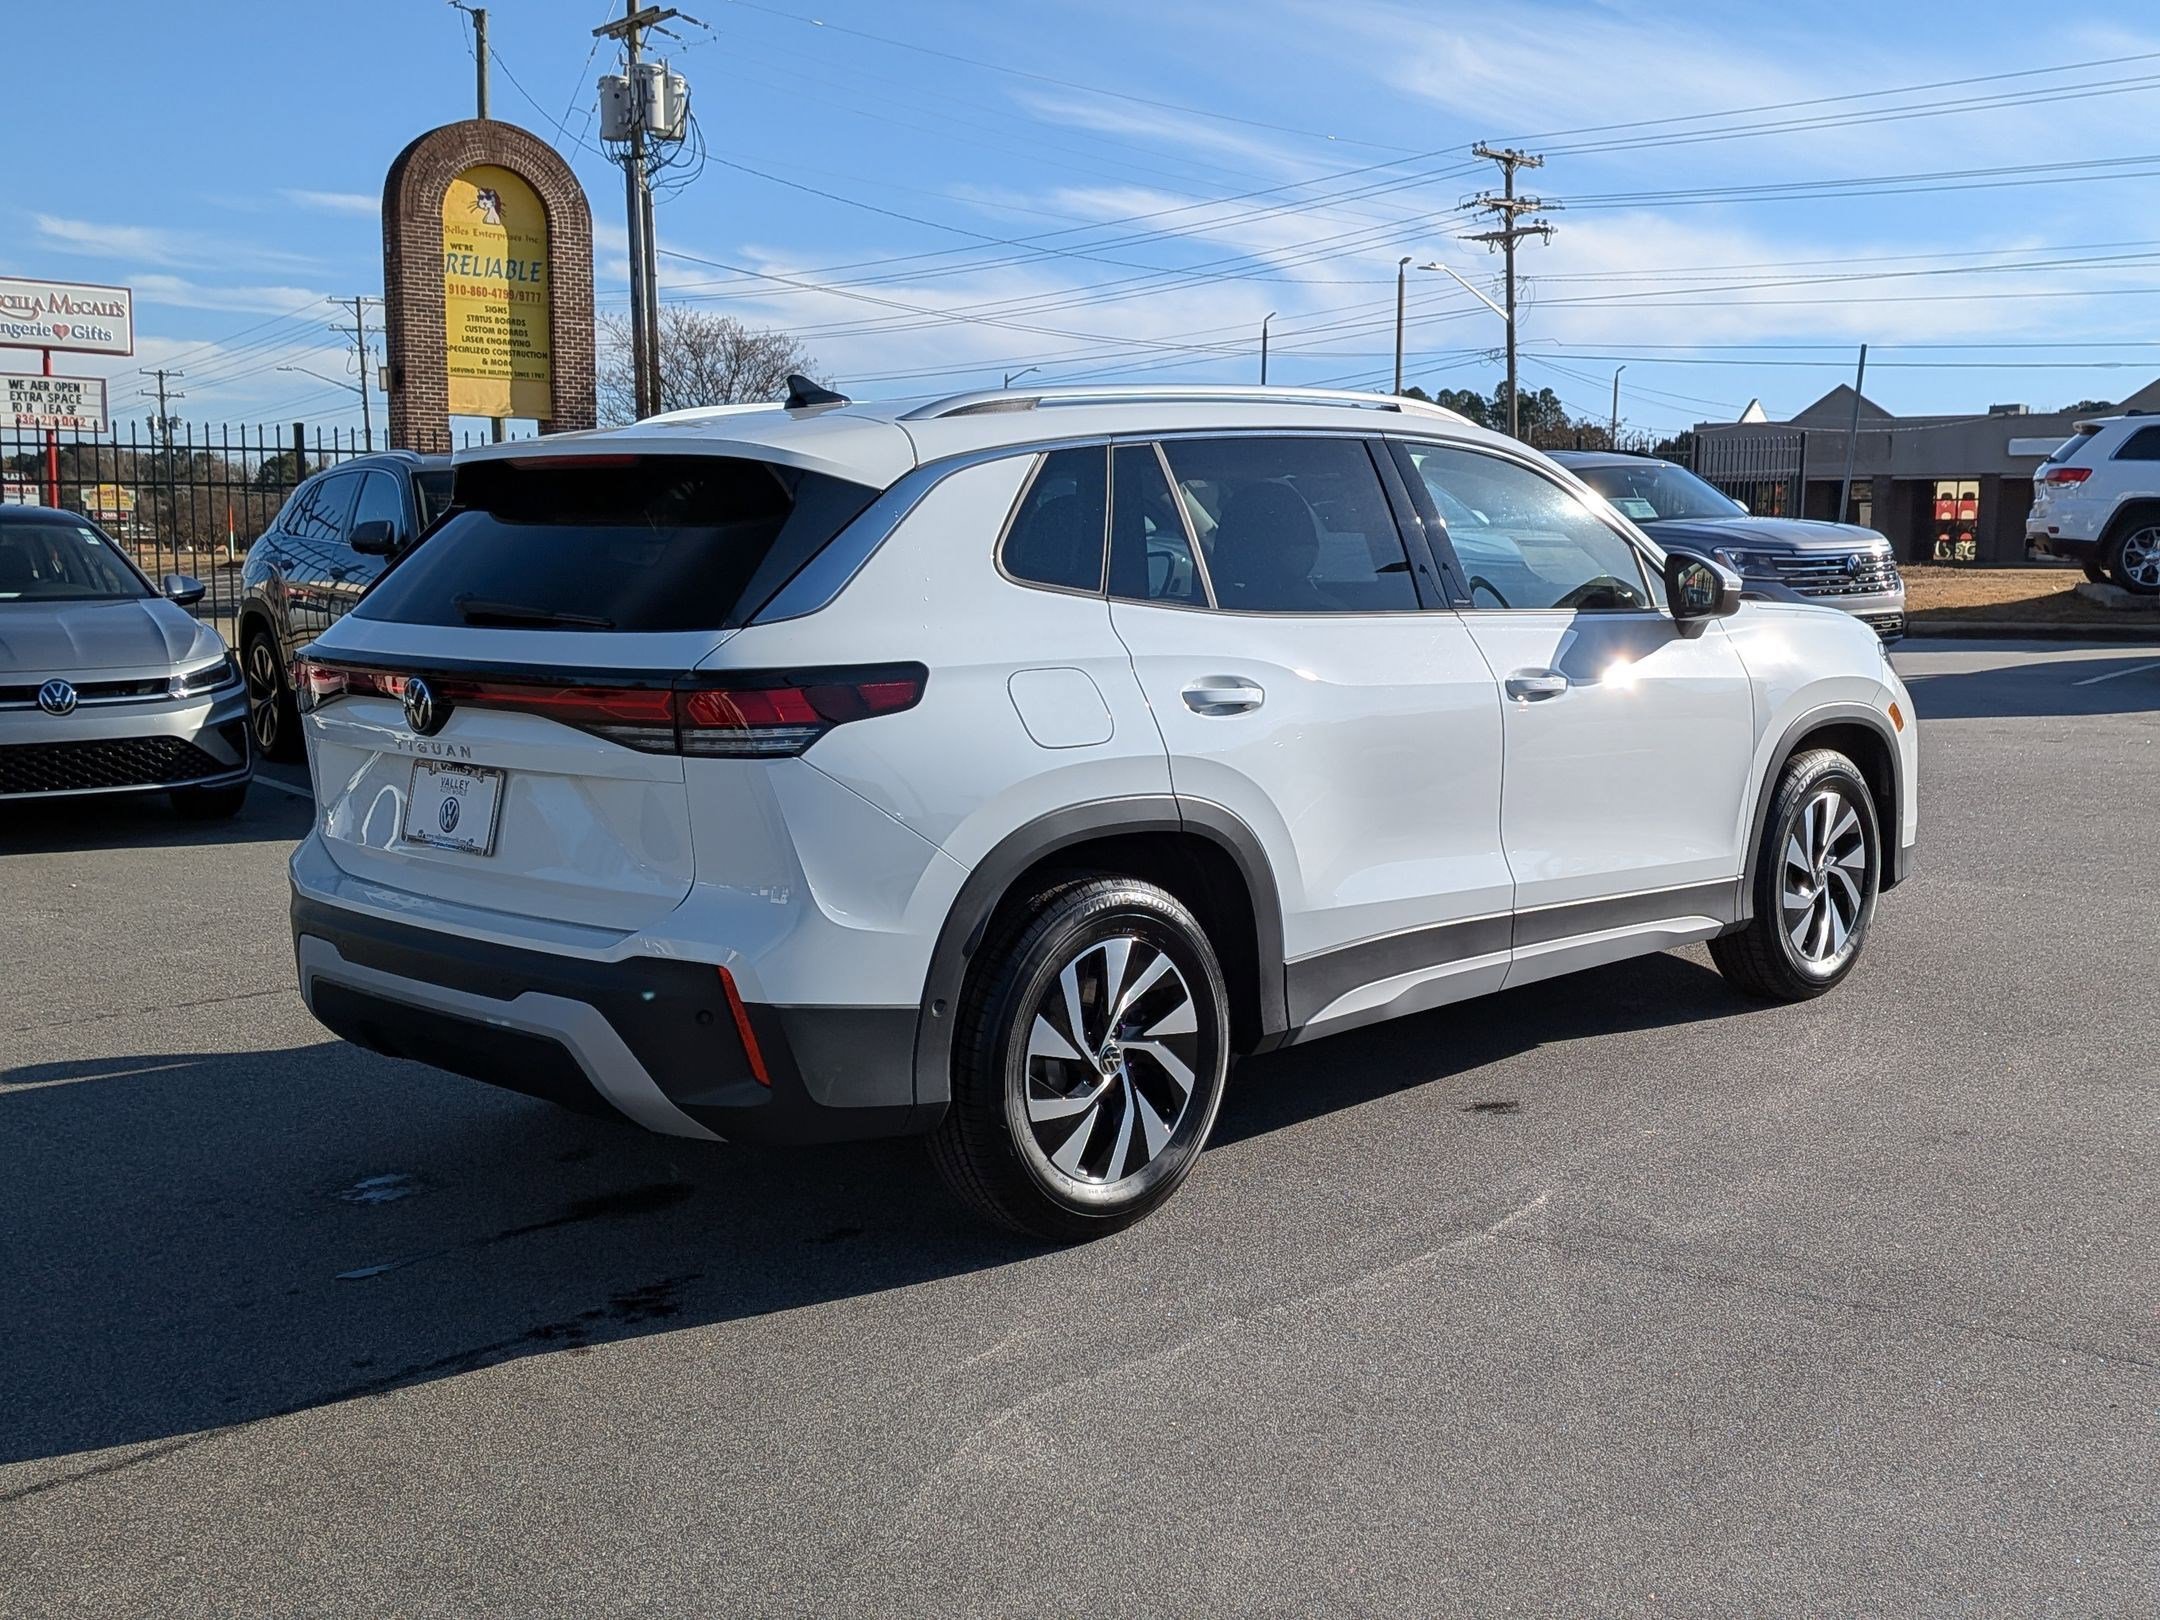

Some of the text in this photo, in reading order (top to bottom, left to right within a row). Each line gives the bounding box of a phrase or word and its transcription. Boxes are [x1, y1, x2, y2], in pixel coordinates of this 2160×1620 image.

[450, 242, 473, 251] WE'RE
[446, 253, 543, 282] RELIABLE
[485, 305, 507, 314] SIGNS
[466, 314, 526, 327] STATUS BOARDS
[0, 322, 112, 341] ngerie Gifts
[464, 325, 528, 337] CUSTOM BOARDS
[461, 335, 531, 348] LASER ENGRAVING
[492, 348, 548, 360] CONSTRUCTION
[490, 359, 512, 367] MORE
[8, 379, 24, 390] WE
[30, 381, 50, 391] AER
[54, 382, 80, 393] OPEN
[10, 391, 82, 404] EXTRA SPACE
[394, 739, 472, 758] TIGUAN
[440, 777, 470, 790] VALLEY
[1083, 892, 1181, 921] BRIDGESTONE
